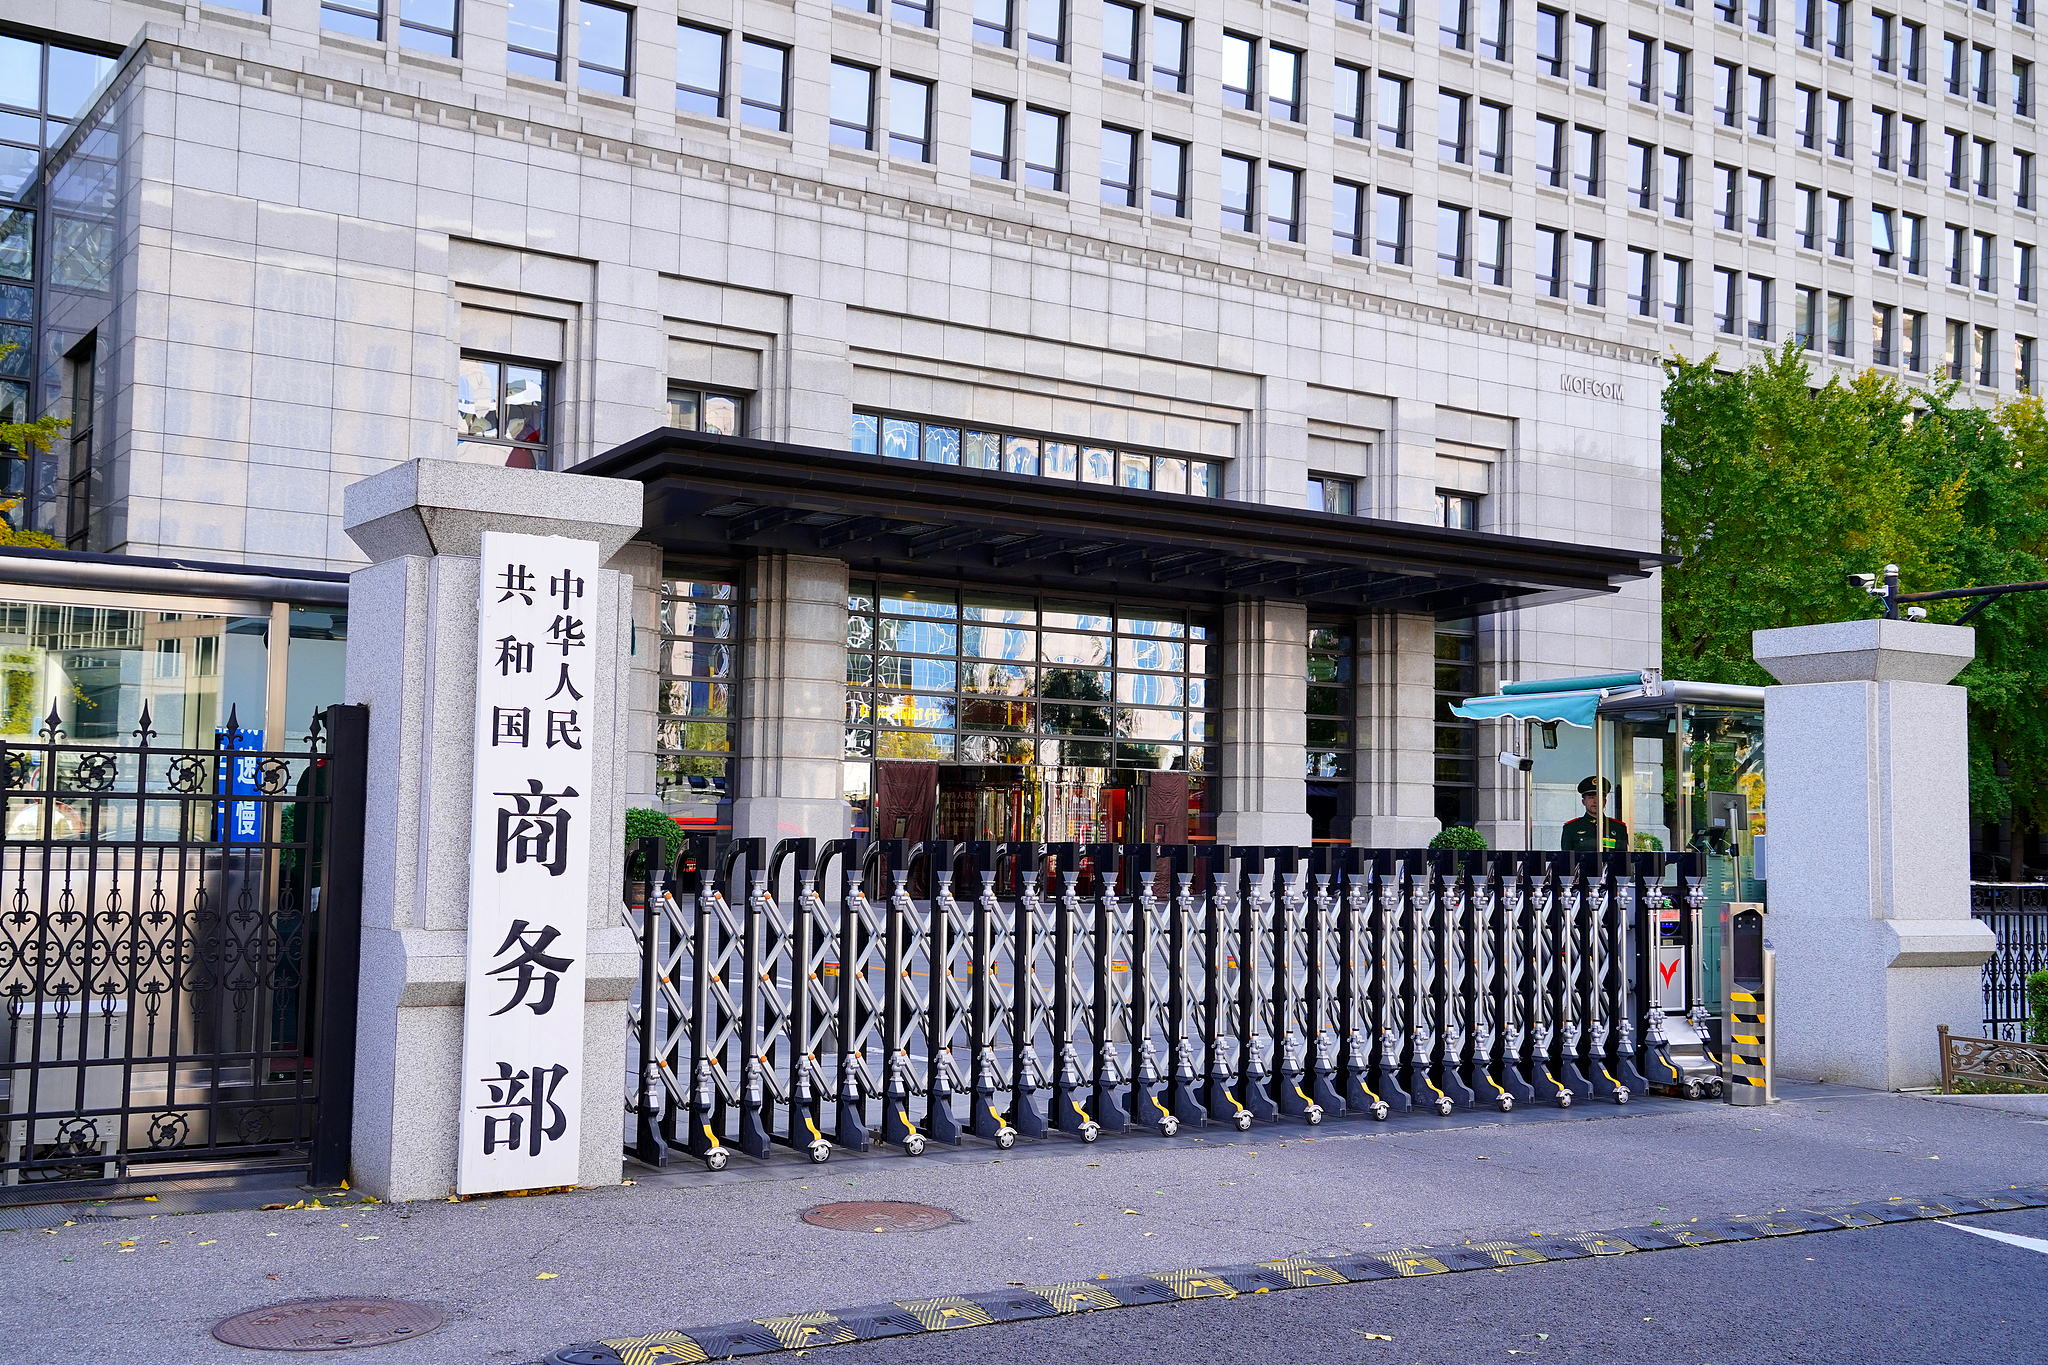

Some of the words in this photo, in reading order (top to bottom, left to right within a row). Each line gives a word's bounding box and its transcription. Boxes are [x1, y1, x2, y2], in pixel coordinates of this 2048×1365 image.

[1561, 374, 1624, 400] MOFCOM
[492, 563, 536, 748] 共和国
[545, 568, 585, 751] 中华人民
[475, 778, 580, 1157] 商务部
